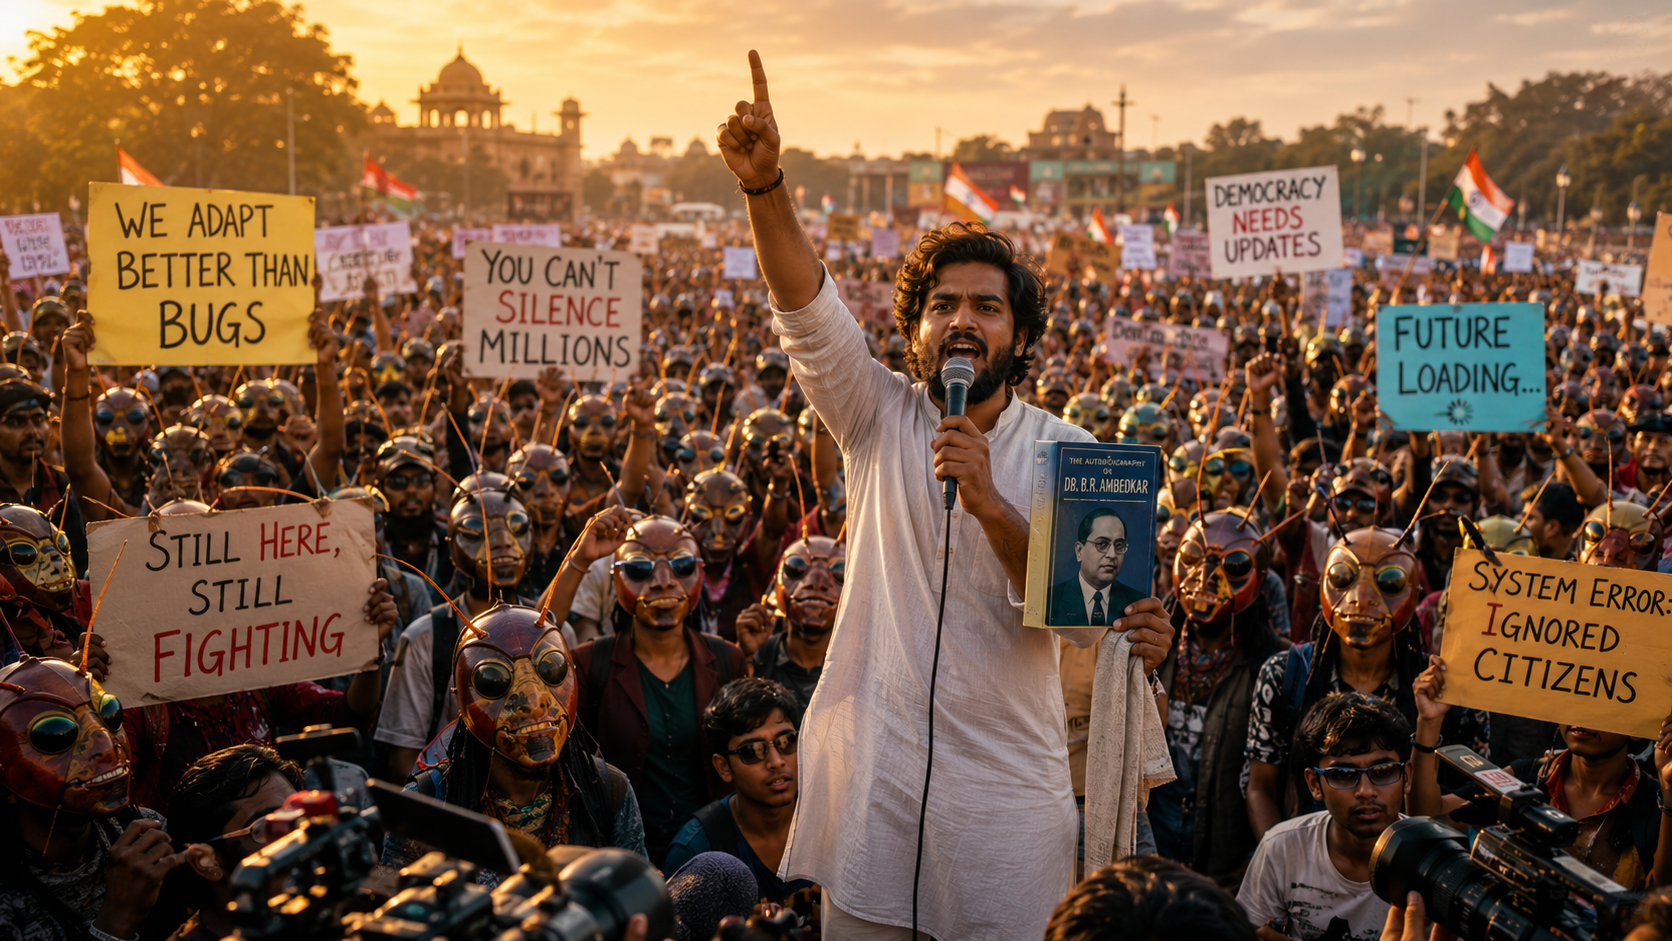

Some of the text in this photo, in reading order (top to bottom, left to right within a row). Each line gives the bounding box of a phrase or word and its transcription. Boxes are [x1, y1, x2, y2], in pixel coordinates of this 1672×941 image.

[1214, 175, 1326, 208] DEMOCRACY
[115, 202, 273, 238] WE ADAPT
[1232, 205, 1303, 235] NEEDS
[1225, 231, 1322, 264] UPDATES
[117, 251, 235, 290] BETTER
[245, 252, 308, 287] THAN
[482, 249, 620, 290] YOU CAN'T
[160, 300, 265, 349] BUGS
[496, 290, 621, 327] SILENCE
[480, 329, 631, 367] MILLIONS
[1395, 316, 1510, 351] FUTURE
[1399, 362, 1540, 396] LOADING...
[146, 521, 340, 571] STILL HERE,
[189, 575, 292, 616] STILL
[1469, 561, 1672, 616] SYSTEM ERROR:
[1481, 602, 1620, 652] IGNORED
[154, 613, 345, 683] FIGHTING
[1474, 648, 1637, 703] CITIZENS
